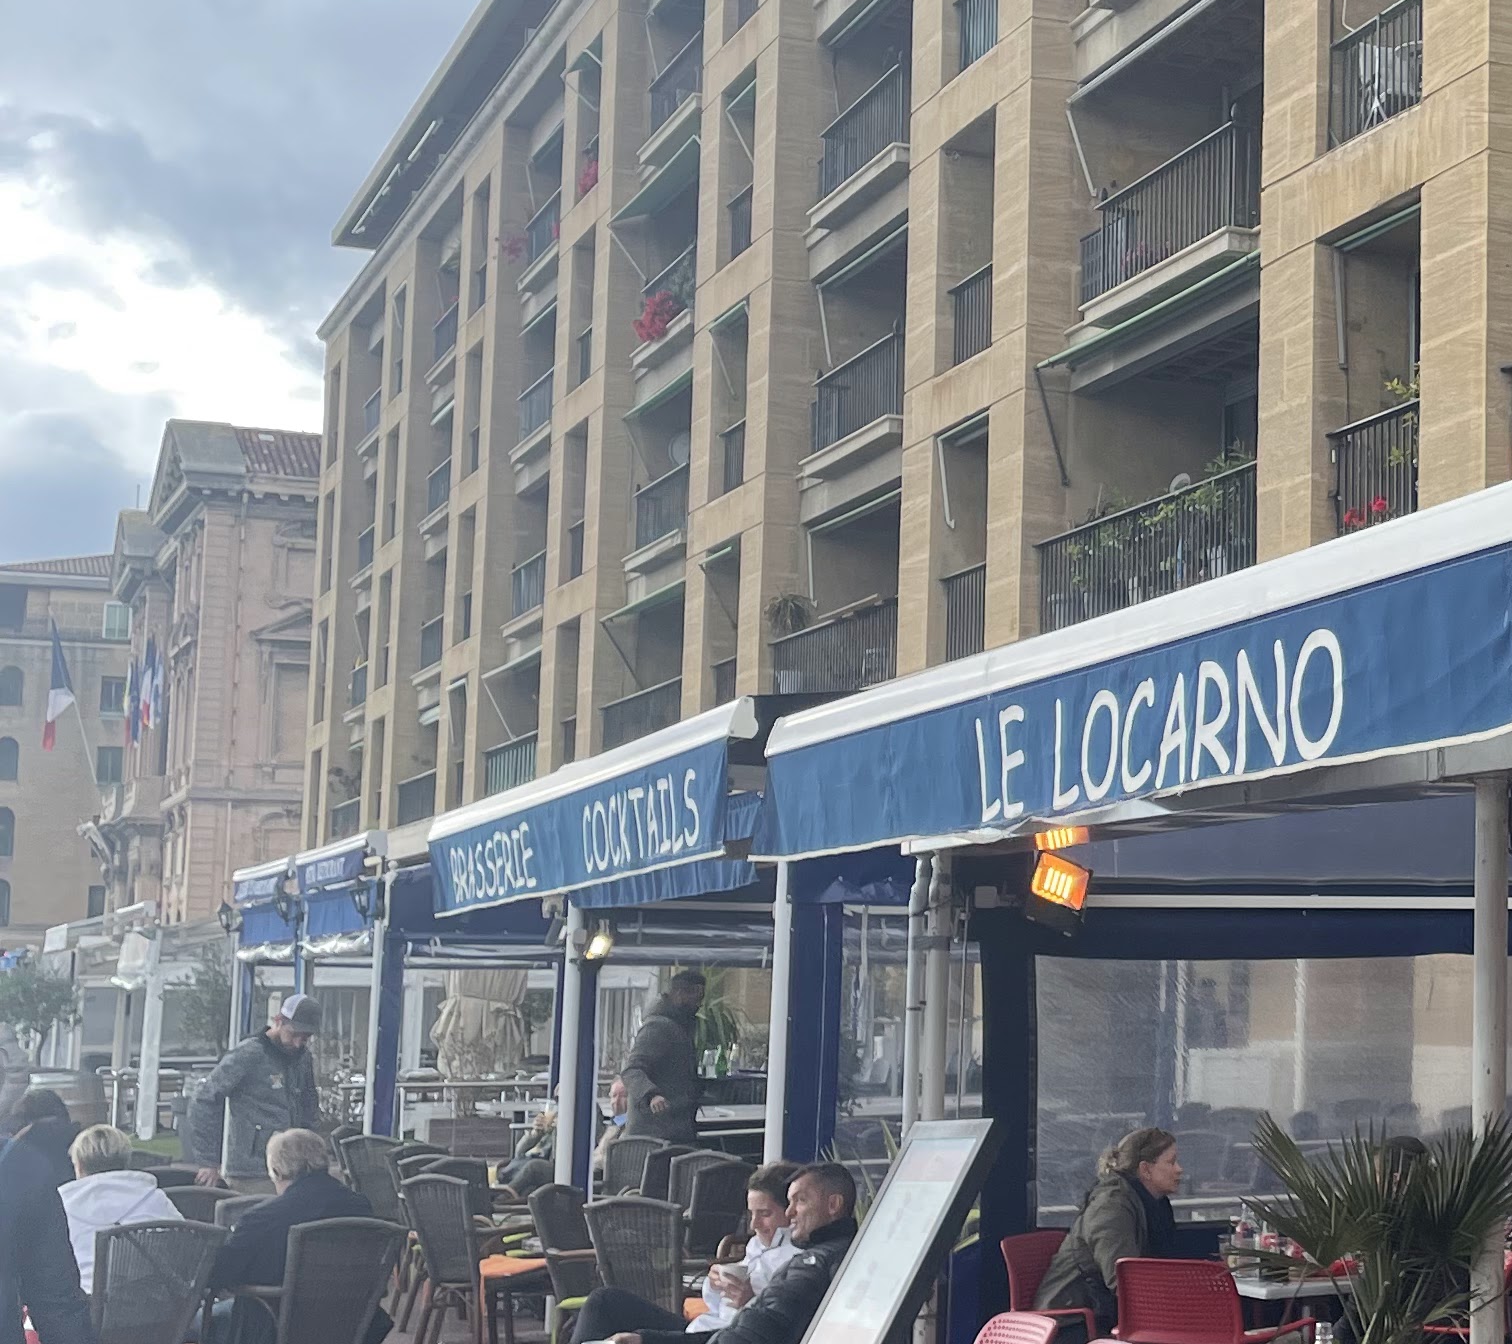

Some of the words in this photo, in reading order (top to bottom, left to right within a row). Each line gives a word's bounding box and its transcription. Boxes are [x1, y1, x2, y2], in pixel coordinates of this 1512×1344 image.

[975, 704, 1026, 823] LE
[1052, 628, 1344, 811] LOCARNO
[450, 821, 537, 904] BRASSERIE
[582, 768, 700, 874] COCKTAILS
